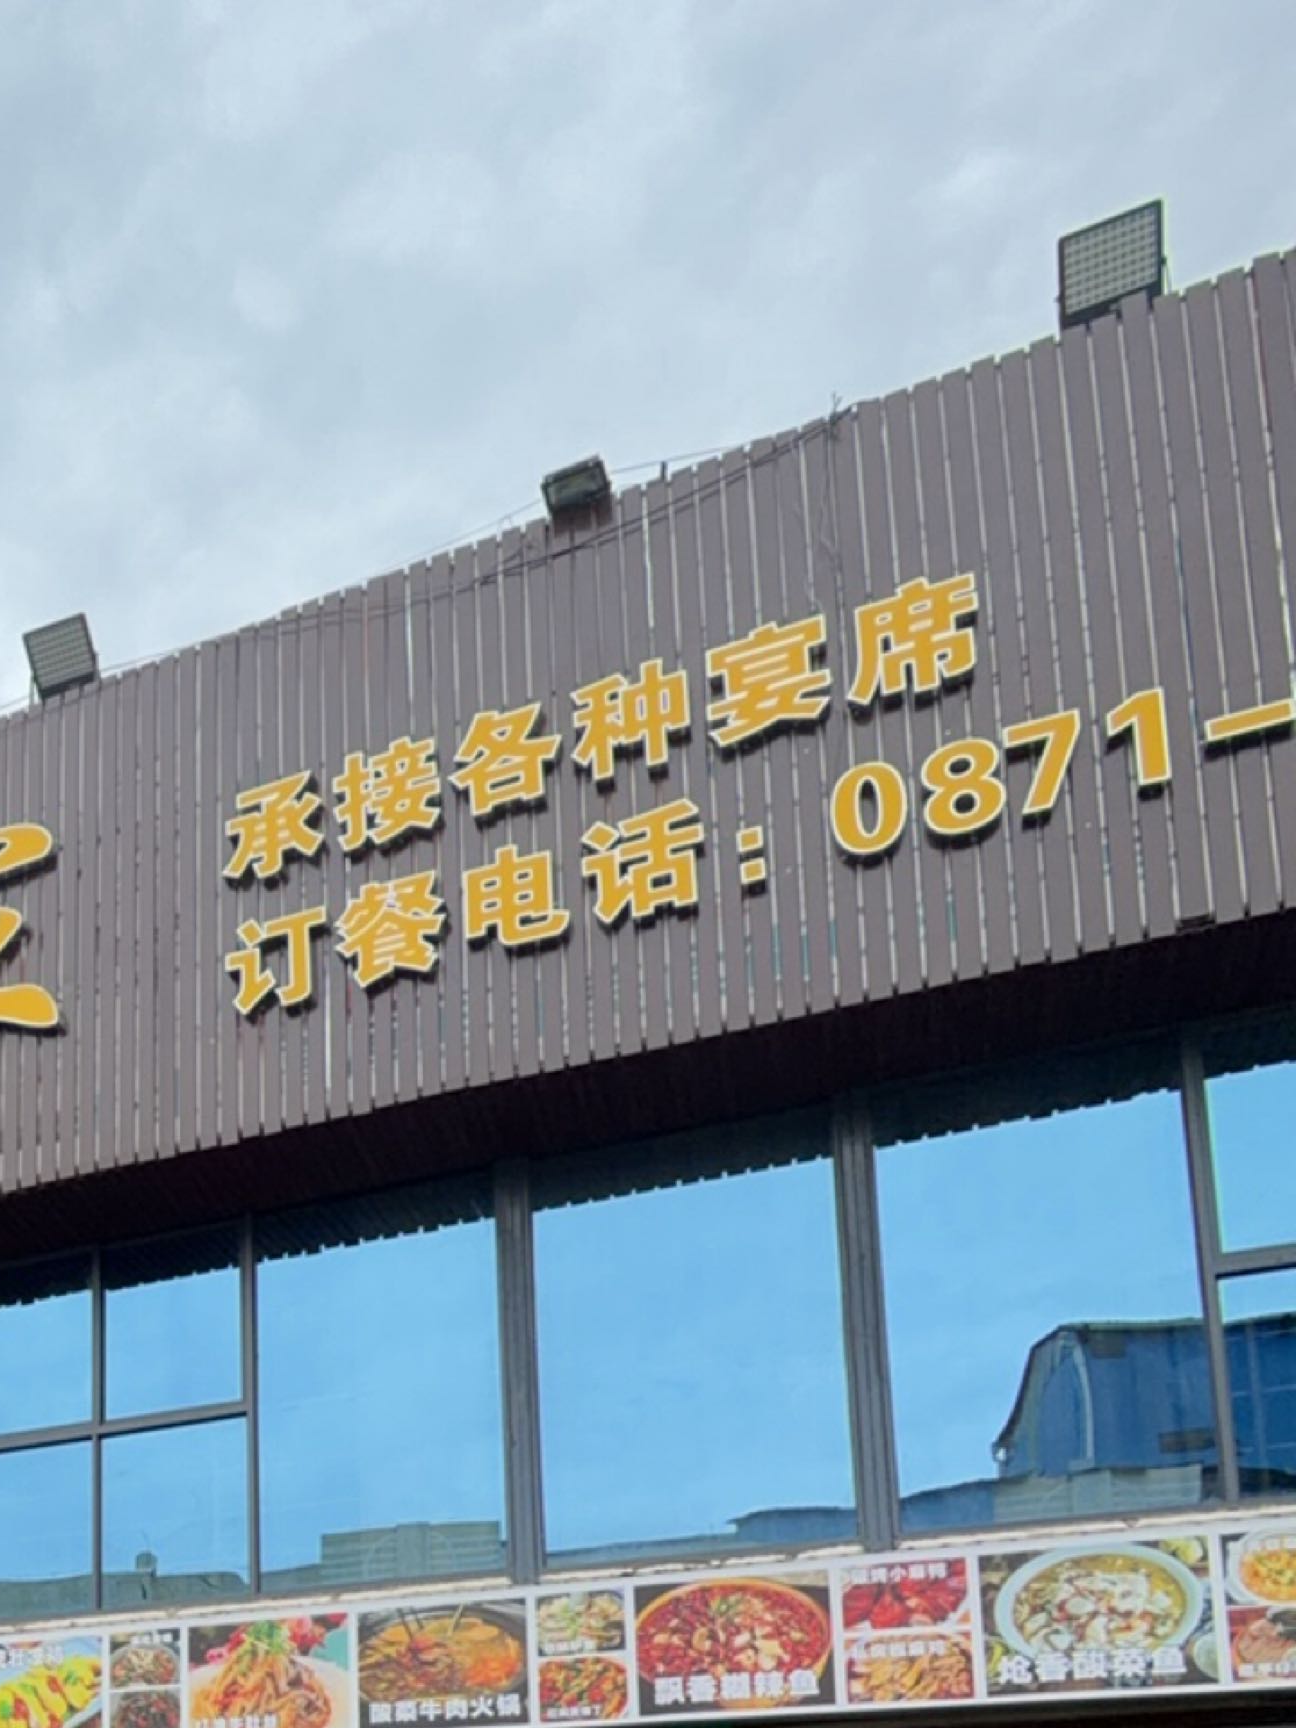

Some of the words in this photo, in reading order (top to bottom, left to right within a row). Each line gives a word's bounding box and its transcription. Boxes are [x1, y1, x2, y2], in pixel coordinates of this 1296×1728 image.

[224, 571, 980, 882] 承接各种宴席
